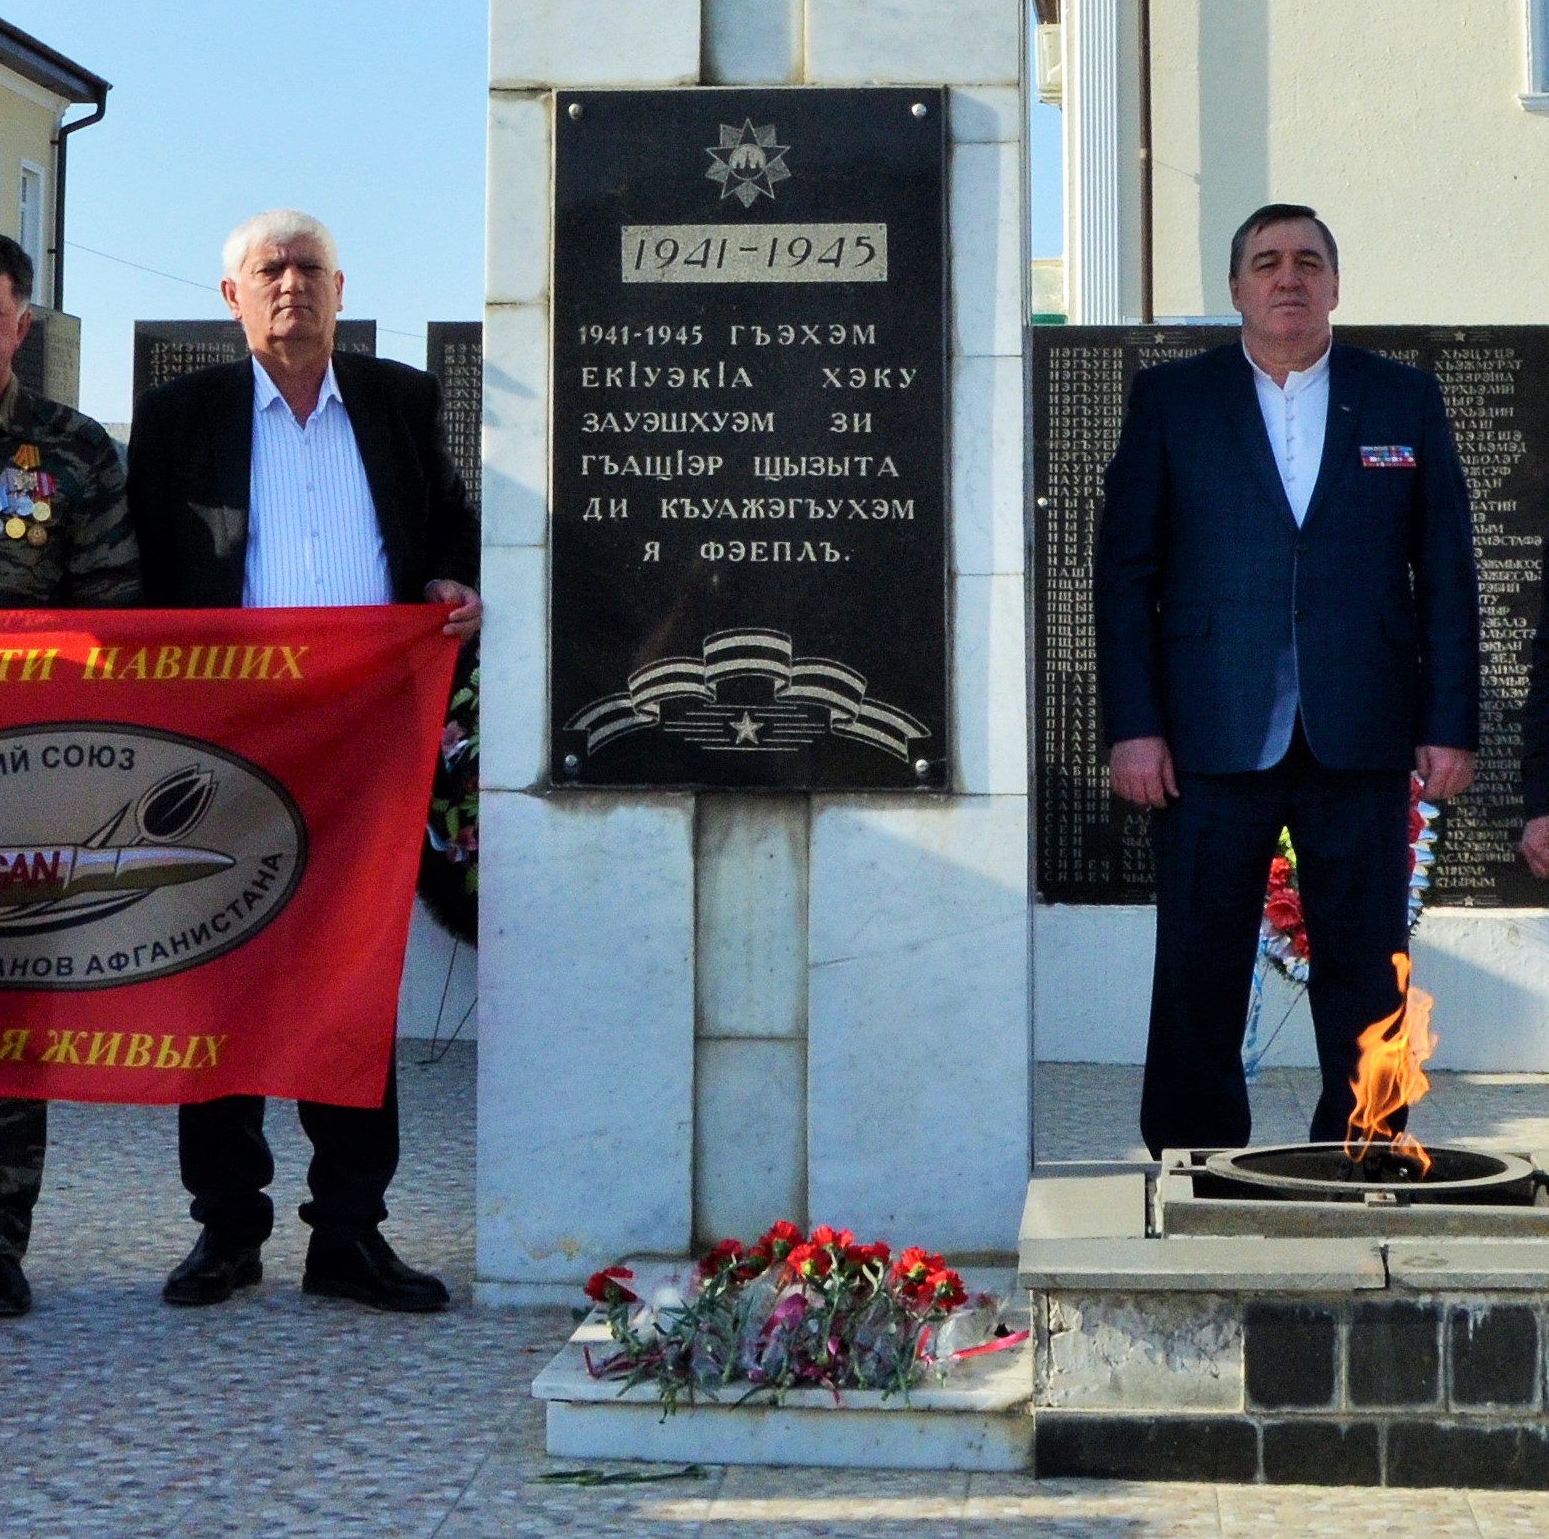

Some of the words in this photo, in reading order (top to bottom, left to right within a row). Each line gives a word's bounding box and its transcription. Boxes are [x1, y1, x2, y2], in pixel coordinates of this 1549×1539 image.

[634, 236, 877, 270] 1941-1945
[579, 324, 703, 346] 1941-1945
[730, 323, 876, 346] ГЪЭХЭМ
[822, 367, 917, 389] ХЭКУ
[581, 411, 776, 433] ЗАУЭШХУЭМ
[829, 411, 873, 433] ЗИ
[753, 455, 900, 482] ЩЫЗЫТА
[582, 497, 629, 521] ДИ
[660, 497, 916, 520] КЪУАЖЭГЪУХЭМ
[643, 540, 661, 562] Я
[699, 540, 851, 563] ФЭЕПЛЪ.
[80, 644, 310, 682] ПАВШИХ
[40, 744, 137, 772] СОЮЗ
[84, 850, 284, 977] АФГАНИСТАНА
[39, 1028, 228, 1070] ЖИВЫХ
